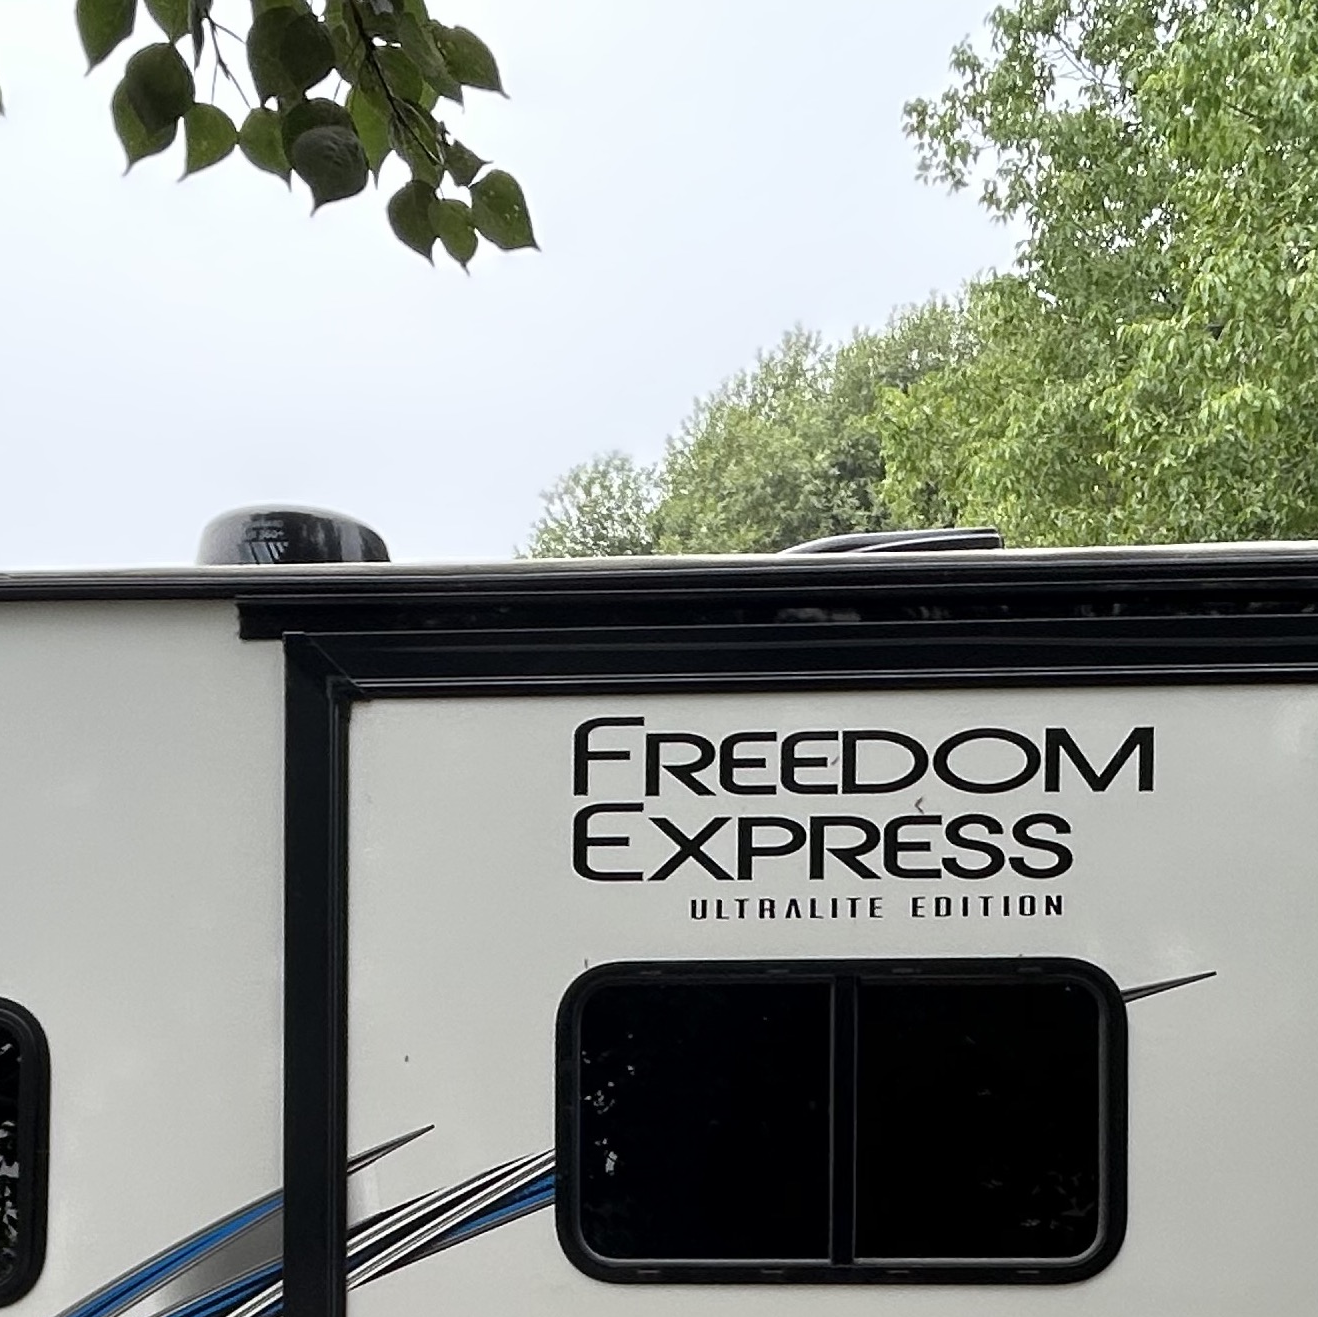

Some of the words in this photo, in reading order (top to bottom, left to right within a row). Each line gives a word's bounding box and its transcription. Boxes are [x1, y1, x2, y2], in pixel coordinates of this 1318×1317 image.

[573, 716, 1155, 797] FREEDOM
[572, 802, 1074, 882] EXPRESS
[690, 897, 883, 920] ULTRALITE
[911, 895, 1063, 918] EDITION
